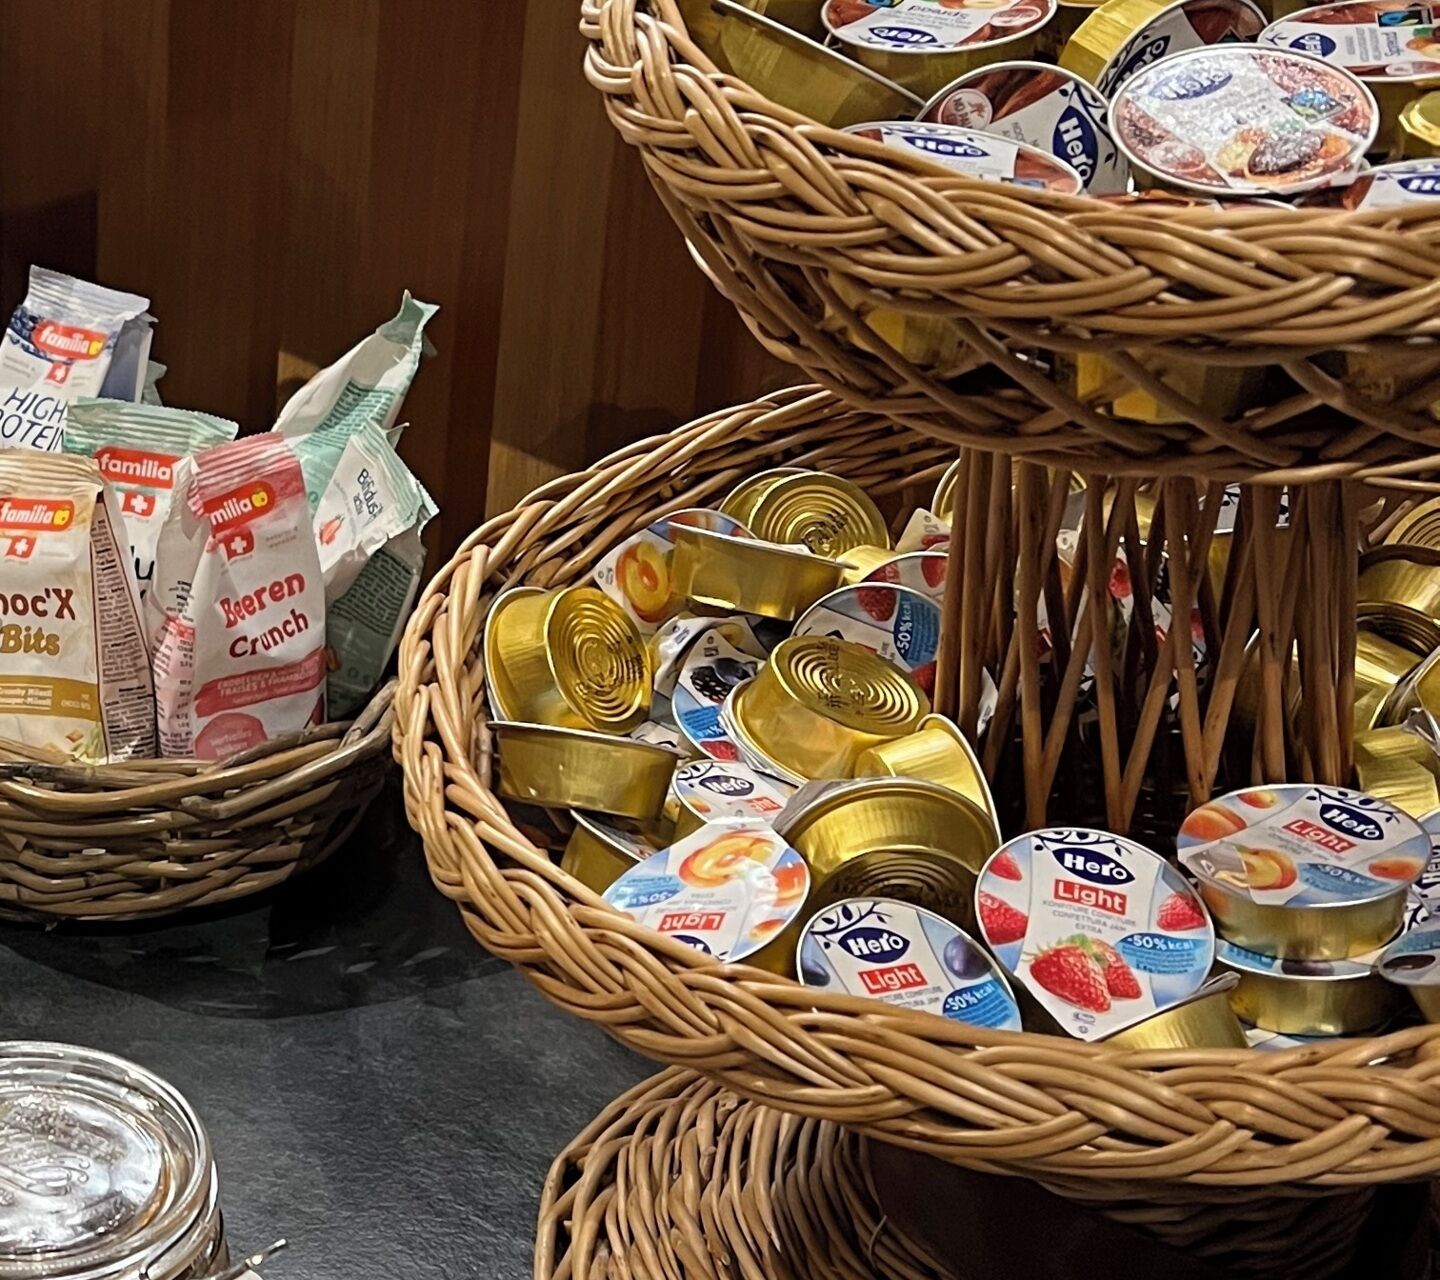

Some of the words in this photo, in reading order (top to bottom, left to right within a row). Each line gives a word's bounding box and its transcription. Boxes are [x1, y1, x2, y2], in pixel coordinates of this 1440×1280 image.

[873, 27, 929, 43] Hero
[1160, 70, 1232, 99] Hero
[915, 138, 983, 156] Hero
[1058, 117, 1093, 181] Hero
[40, 326, 89, 354] familia
[4, 387, 68, 423] HIGH
[101, 454, 171, 481] familia
[0, 502, 53, 524] familia
[220, 572, 306, 629] Beeren
[229, 608, 309, 658] Crunch
[705, 778, 751, 793] Hero
[1290, 820, 1349, 851] Light
[1323, 808, 1380, 839] Hero
[1063, 853, 1128, 881] Hero
[1058, 881, 1124, 912] Light
[663, 913, 720, 930] Light
[1053, 911, 1108, 930] CONFETTURA
[1074, 922, 1103, 934] EXTRA
[847, 933, 904, 956] Hero
[863, 965, 922, 990] Light
